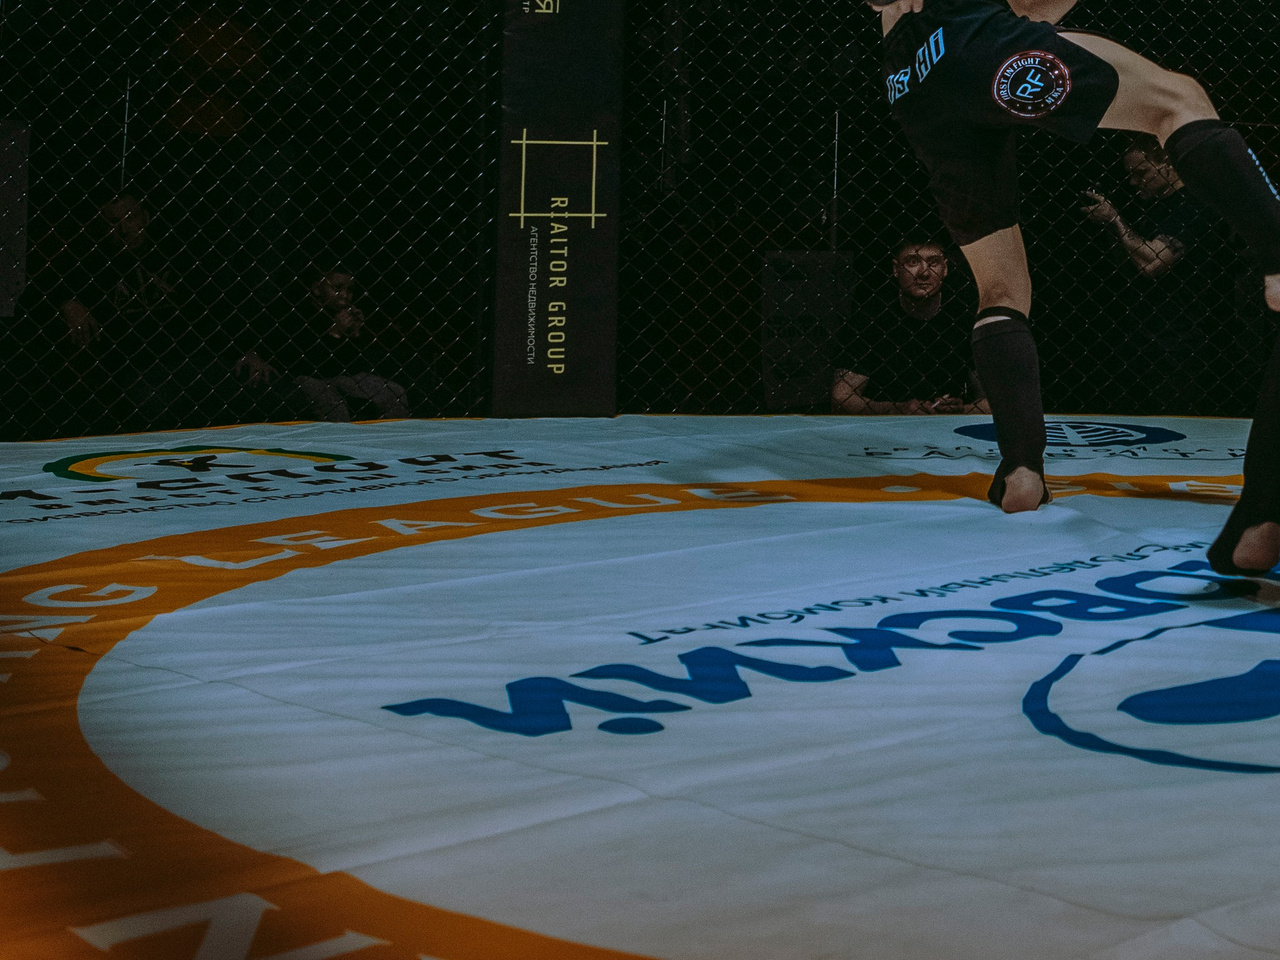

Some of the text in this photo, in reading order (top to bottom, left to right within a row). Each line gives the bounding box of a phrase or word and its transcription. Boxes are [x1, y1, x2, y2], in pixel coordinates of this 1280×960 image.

[1012, 58, 1041, 72] FIGHT
[1015, 68, 1045, 99] RF
[527, 225, 539, 365] АГЕНТСТВО НЕДВИЖИМОСТИ
[547, 197, 569, 375] RIALTOR GROUP
[0, 501, 236, 524] ОИЗВОДСТВО
[242, 477, 459, 503] СПОРТИВНОГО
[31, 461, 556, 510] ВМЕСТЕ МЫ СИЛА
[131, 487, 798, 570] LEAGUE
